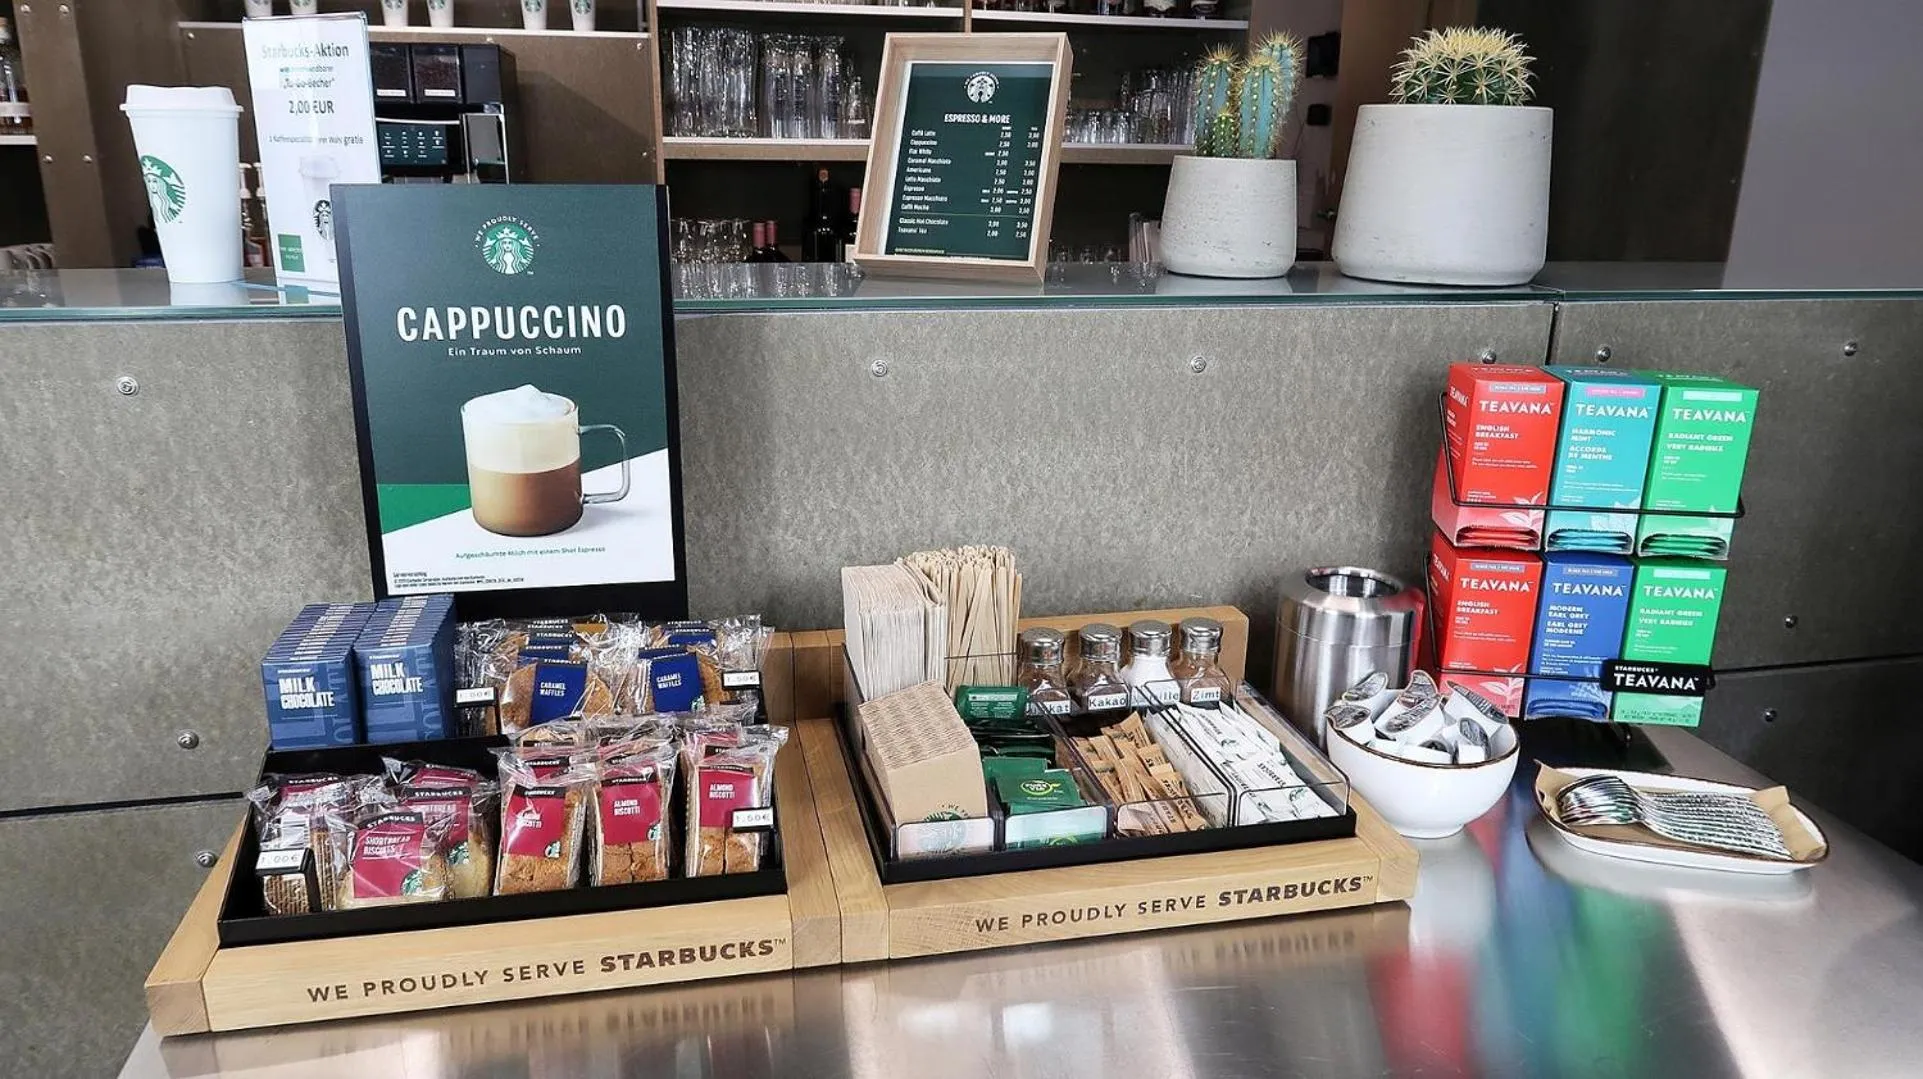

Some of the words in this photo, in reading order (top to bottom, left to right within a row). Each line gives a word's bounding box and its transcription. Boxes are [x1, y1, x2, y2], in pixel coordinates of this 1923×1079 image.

[288, 99, 311, 116] 2,00
[313, 99, 335, 115] EUR
[944, 113, 981, 124] ESPRESSO
[981, 114, 989, 124] &
[989, 114, 1011, 124] MORE
[474, 228, 484, 243] WE
[482, 215, 518, 231] PROUDLY
[519, 218, 540, 241] SERVE
[396, 304, 627, 342] CAPPUCCINO
[448, 346, 466, 357] Ein
[470, 346, 508, 357] Traum
[511, 347, 532, 356] von
[535, 345, 582, 356] Schaum
[1479, 400, 1552, 415] TEAVANA
[1575, 403, 1649, 419] TEAVANA
[1672, 408, 1747, 423] TEAVANA
[1475, 424, 1510, 432] ENGLISH
[1474, 431, 1519, 440] BREAKFAST
[1460, 577, 1531, 592] TEAVANA
[1552, 582, 1624, 597] TEAVANA
[1643, 584, 1716, 600] TEAVANA
[1456, 600, 1491, 608] ENGLISH
[1549, 604, 1584, 613] MODERN
[1456, 607, 1499, 616] BREAKFAST
[1547, 620, 1566, 628] EARL
[1545, 627, 1584, 635] MODERNE
[370, 662, 405, 680] MILK
[656, 672, 682, 683] CARAMEL
[1613, 672, 1697, 692] TEAVANA
[279, 676, 316, 694] MILK
[372, 677, 424, 696] CHOCOLATE
[540, 681, 566, 690] CARAMEL
[657, 680, 682, 690] WAFFLES
[539, 688, 565, 698] WAFFLES
[1192, 691, 1220, 701] Zimt
[280, 691, 336, 710] CHOCOLATE
[1089, 697, 1127, 708] Kakao
[288, 776, 339, 784] STARBUCKS
[709, 783, 734, 792] ALMOND
[415, 789, 464, 799] STARBUCKS
[708, 790, 736, 800] BISCOTTI
[614, 799, 638, 808] ALMOND
[613, 806, 640, 816] BISCOTTI
[974, 916, 1009, 933] WE
[1020, 903, 1126, 929] PROUDLY
[1138, 893, 1207, 916] SERVE
[307, 983, 350, 1004] WE
[363, 970, 489, 998] PROUDLY
[503, 959, 587, 985] SERVE
